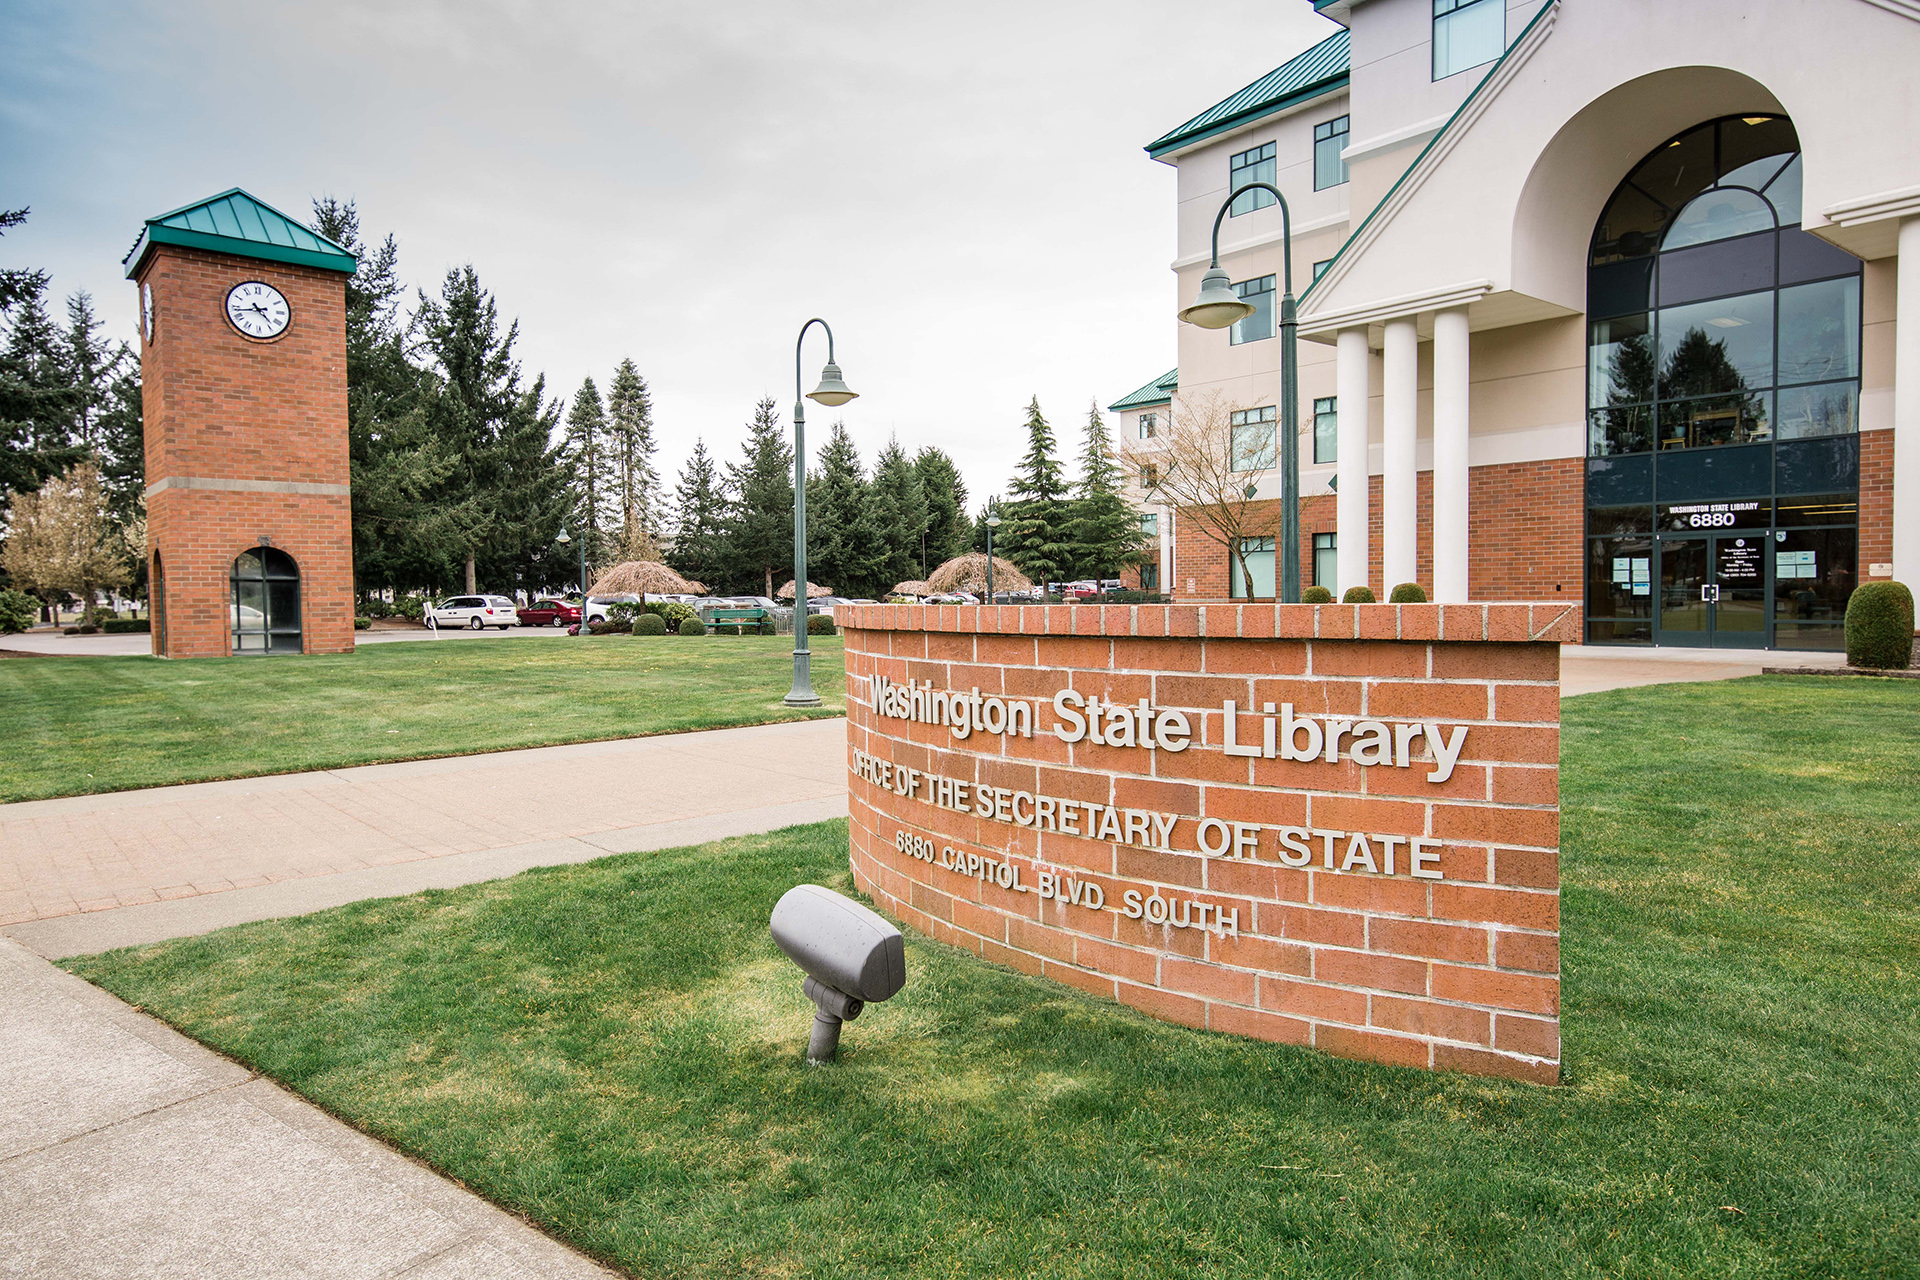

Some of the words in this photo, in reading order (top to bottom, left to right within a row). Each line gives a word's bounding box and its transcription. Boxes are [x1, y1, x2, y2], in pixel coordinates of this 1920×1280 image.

[1669, 505, 1709, 514] WASHINGTON
[1710, 503, 1729, 512] STATE
[1730, 502, 1759, 511] LIBRARY
[1689, 513, 1736, 528] 6880
[869, 673, 1032, 739] Washington
[1052, 688, 1192, 752] State
[1223, 699, 1469, 783] Library
[852, 747, 893, 791] OFFICE
[895, 764, 922, 799] OF
[924, 774, 972, 812] THE
[975, 784, 1179, 849] SECRETARY
[1197, 817, 1261, 859] OF
[1278, 825, 1444, 879] STATE
[896, 829, 934, 864] 6880
[942, 845, 1027, 893] CAPITOL
[1038, 871, 1104, 911] BLVD
[1122, 889, 1239, 937] SOUTH
